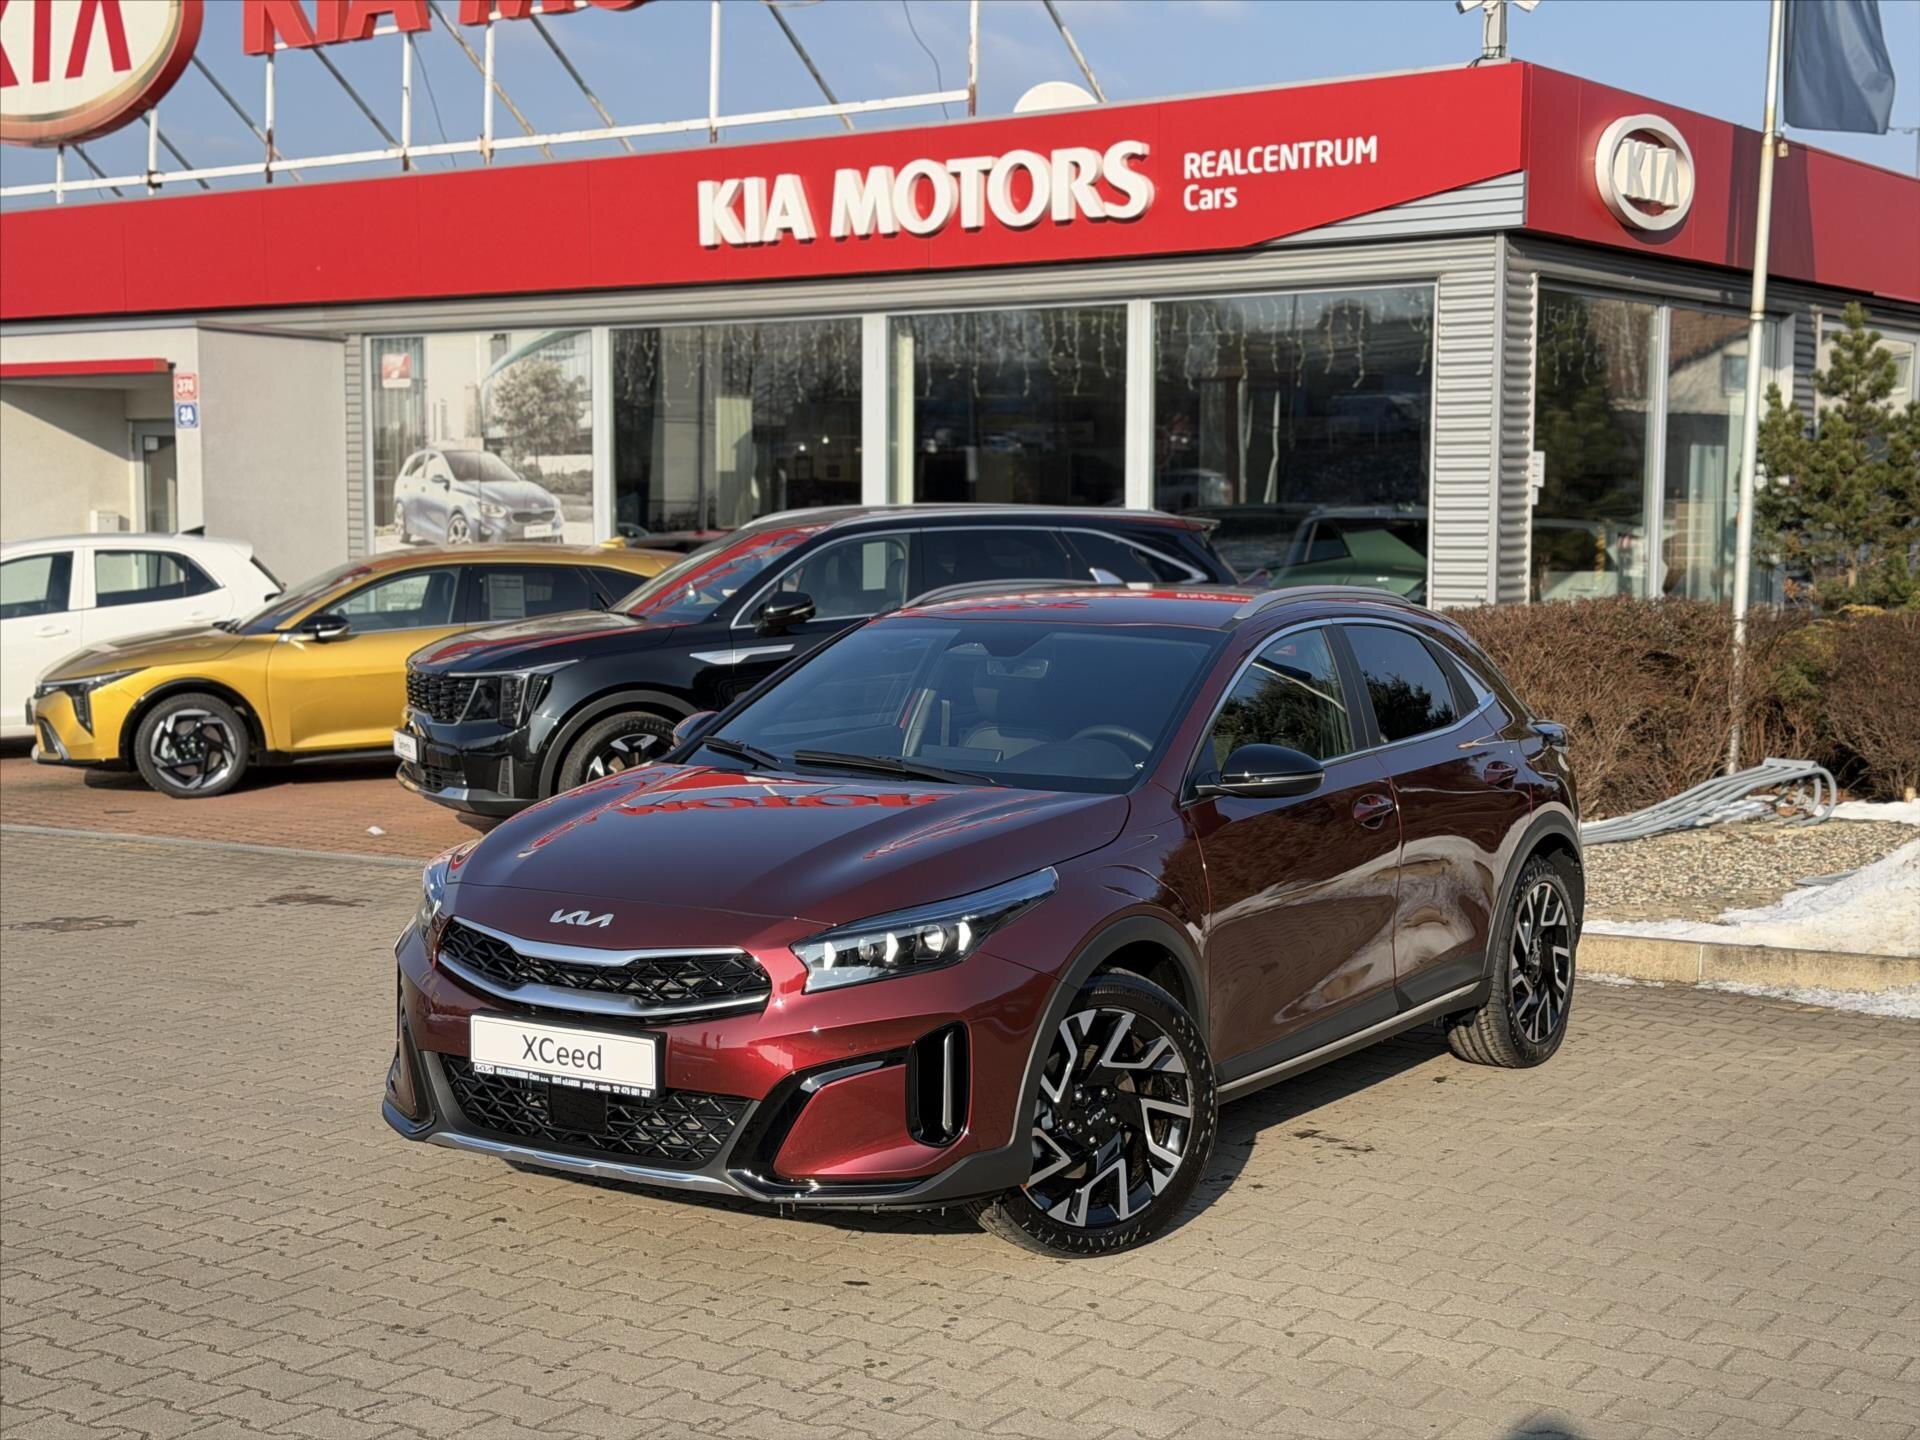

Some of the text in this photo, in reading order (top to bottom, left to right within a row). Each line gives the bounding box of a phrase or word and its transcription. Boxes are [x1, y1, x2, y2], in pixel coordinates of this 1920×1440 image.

[0, 0, 132, 88] IA
[1184, 135, 1378, 180] REALCENTRUM
[1614, 138, 1680, 207] KIA
[698, 140, 1155, 247] KIA MOTORS
[1184, 184, 1238, 212] Cars
[180, 406, 194, 421] 2A
[550, 909, 614, 928] KIA
[522, 1034, 602, 1071] XCeed
